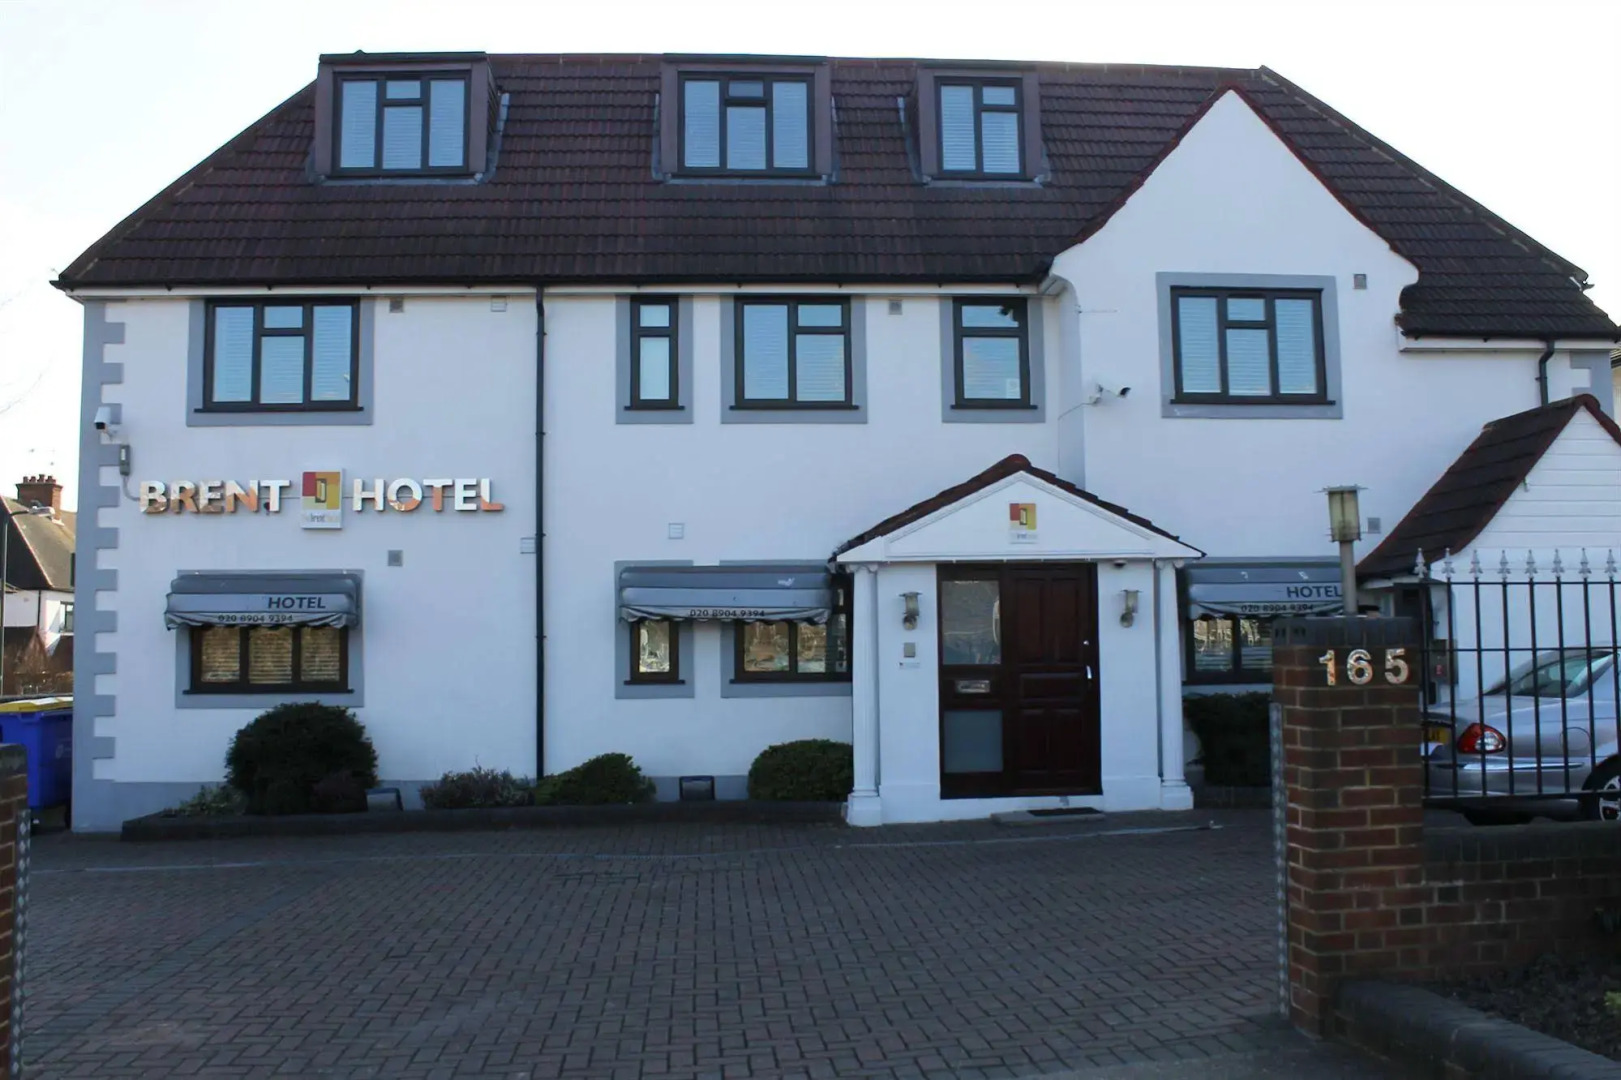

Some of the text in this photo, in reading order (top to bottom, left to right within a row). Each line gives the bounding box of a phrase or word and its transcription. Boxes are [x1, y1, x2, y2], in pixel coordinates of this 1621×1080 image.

[139, 478, 504, 514] BRENT HOTEL
[1286, 586, 1344, 598] HOTEL
[267, 597, 326, 609] HOTEL
[1241, 605, 1259, 613] 020
[1262, 605, 1287, 613] 8904
[218, 614, 237, 622] 020
[268, 614, 293, 623] 9394
[689, 609, 765, 617] 020 8904 9394
[1319, 648, 1409, 686] 165
